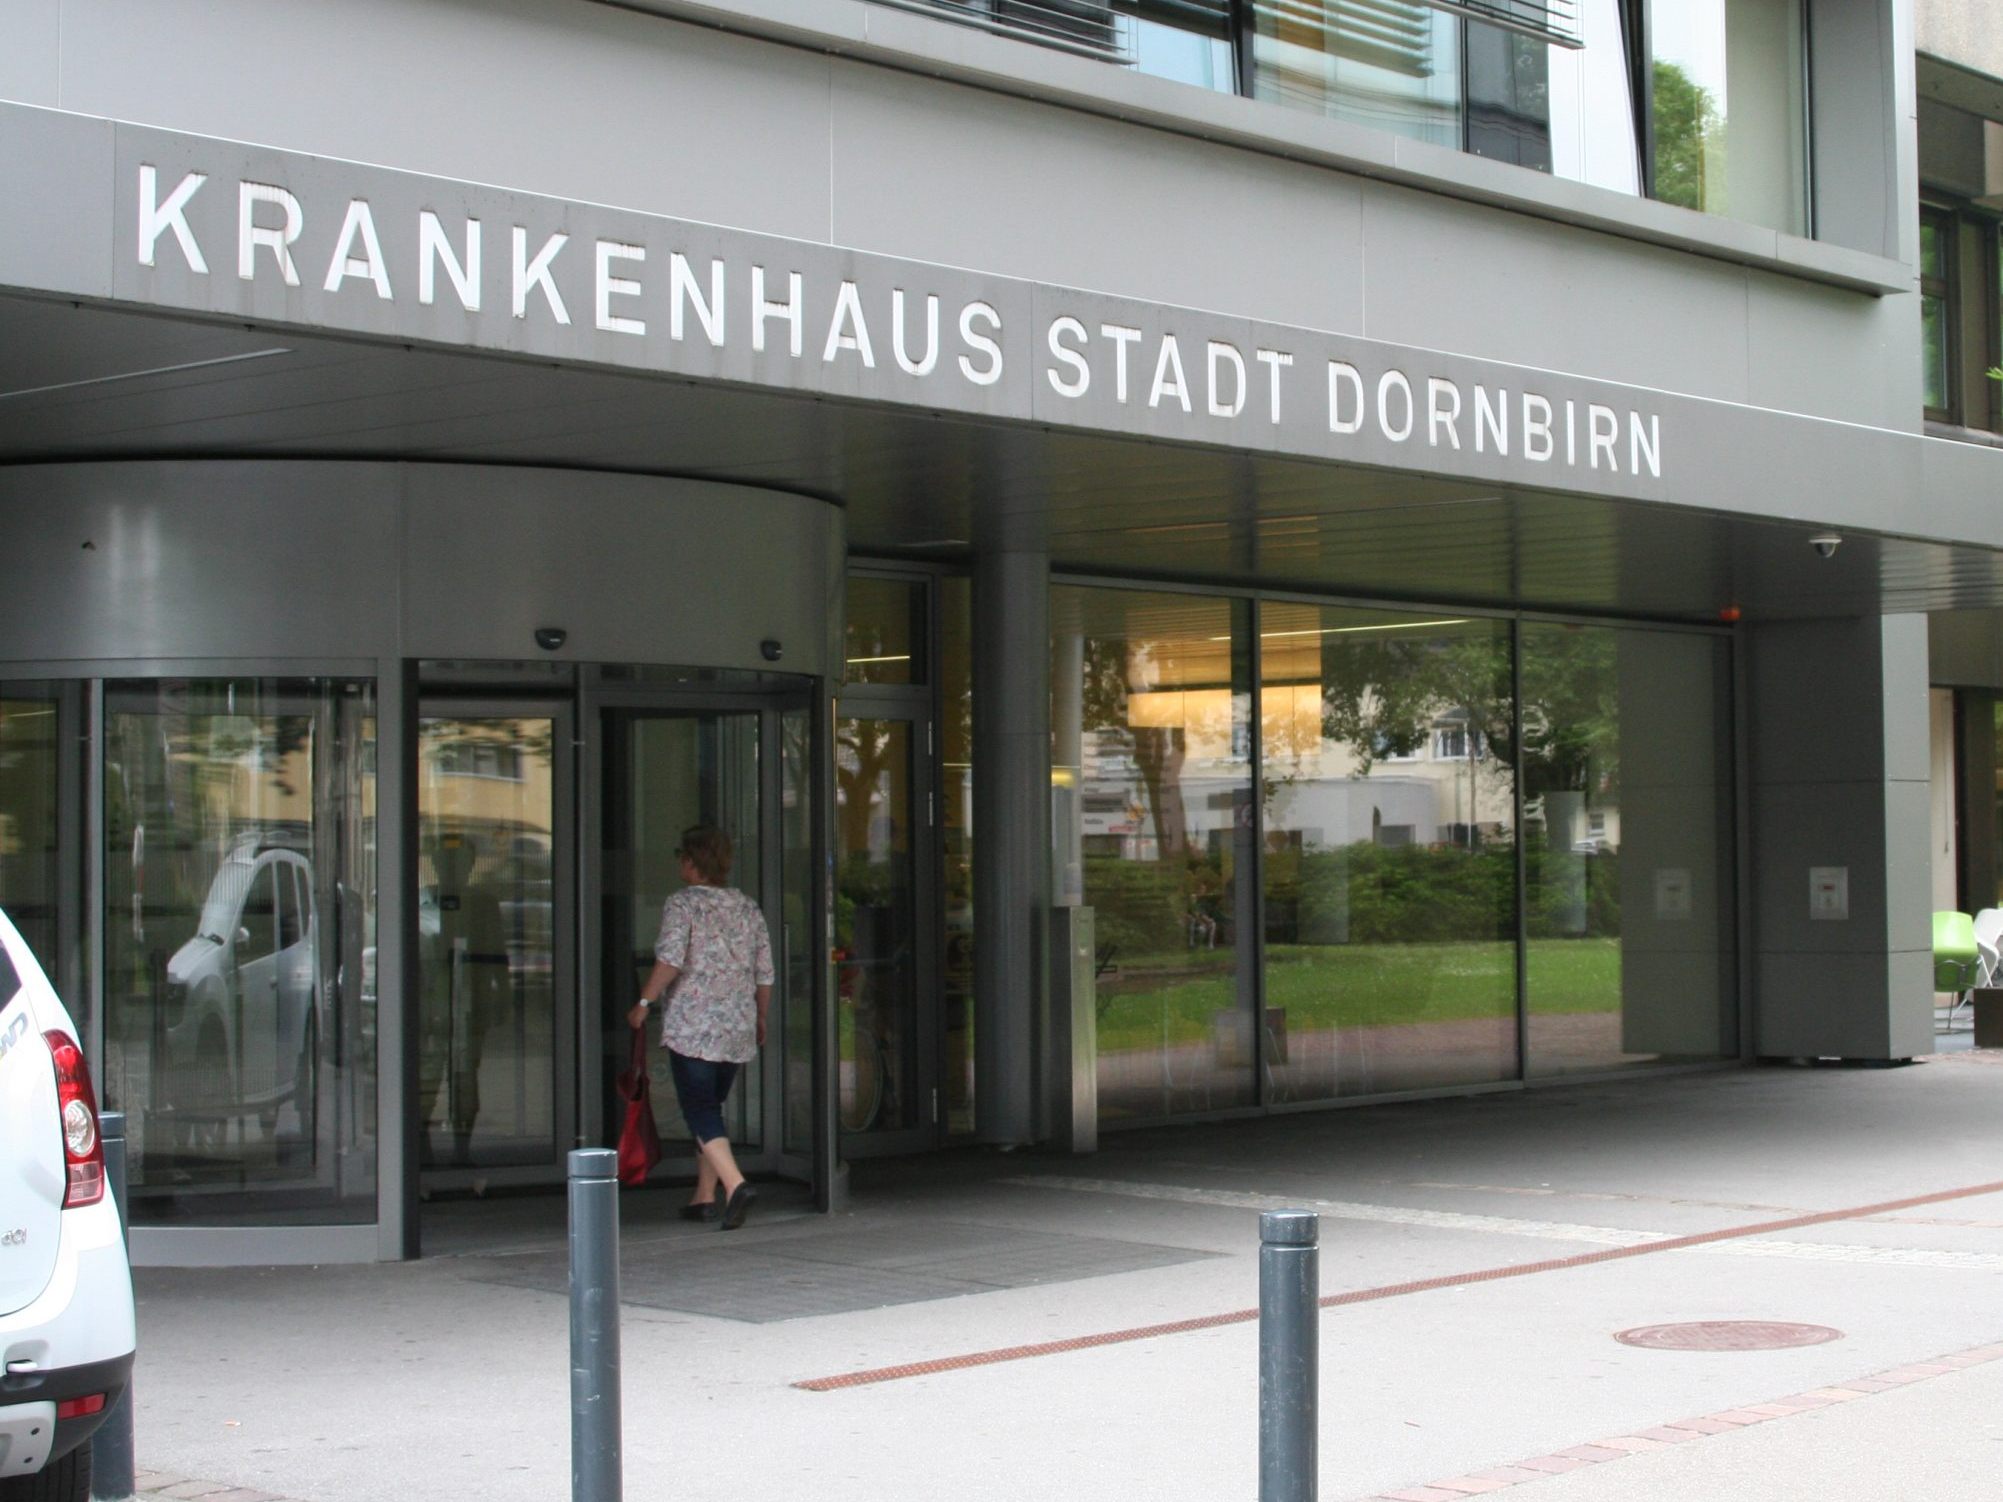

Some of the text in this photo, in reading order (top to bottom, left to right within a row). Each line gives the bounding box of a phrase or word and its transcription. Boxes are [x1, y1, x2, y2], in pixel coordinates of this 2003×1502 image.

[137, 163, 1662, 478] KRANKENHAUS STADT DORNBIRN
